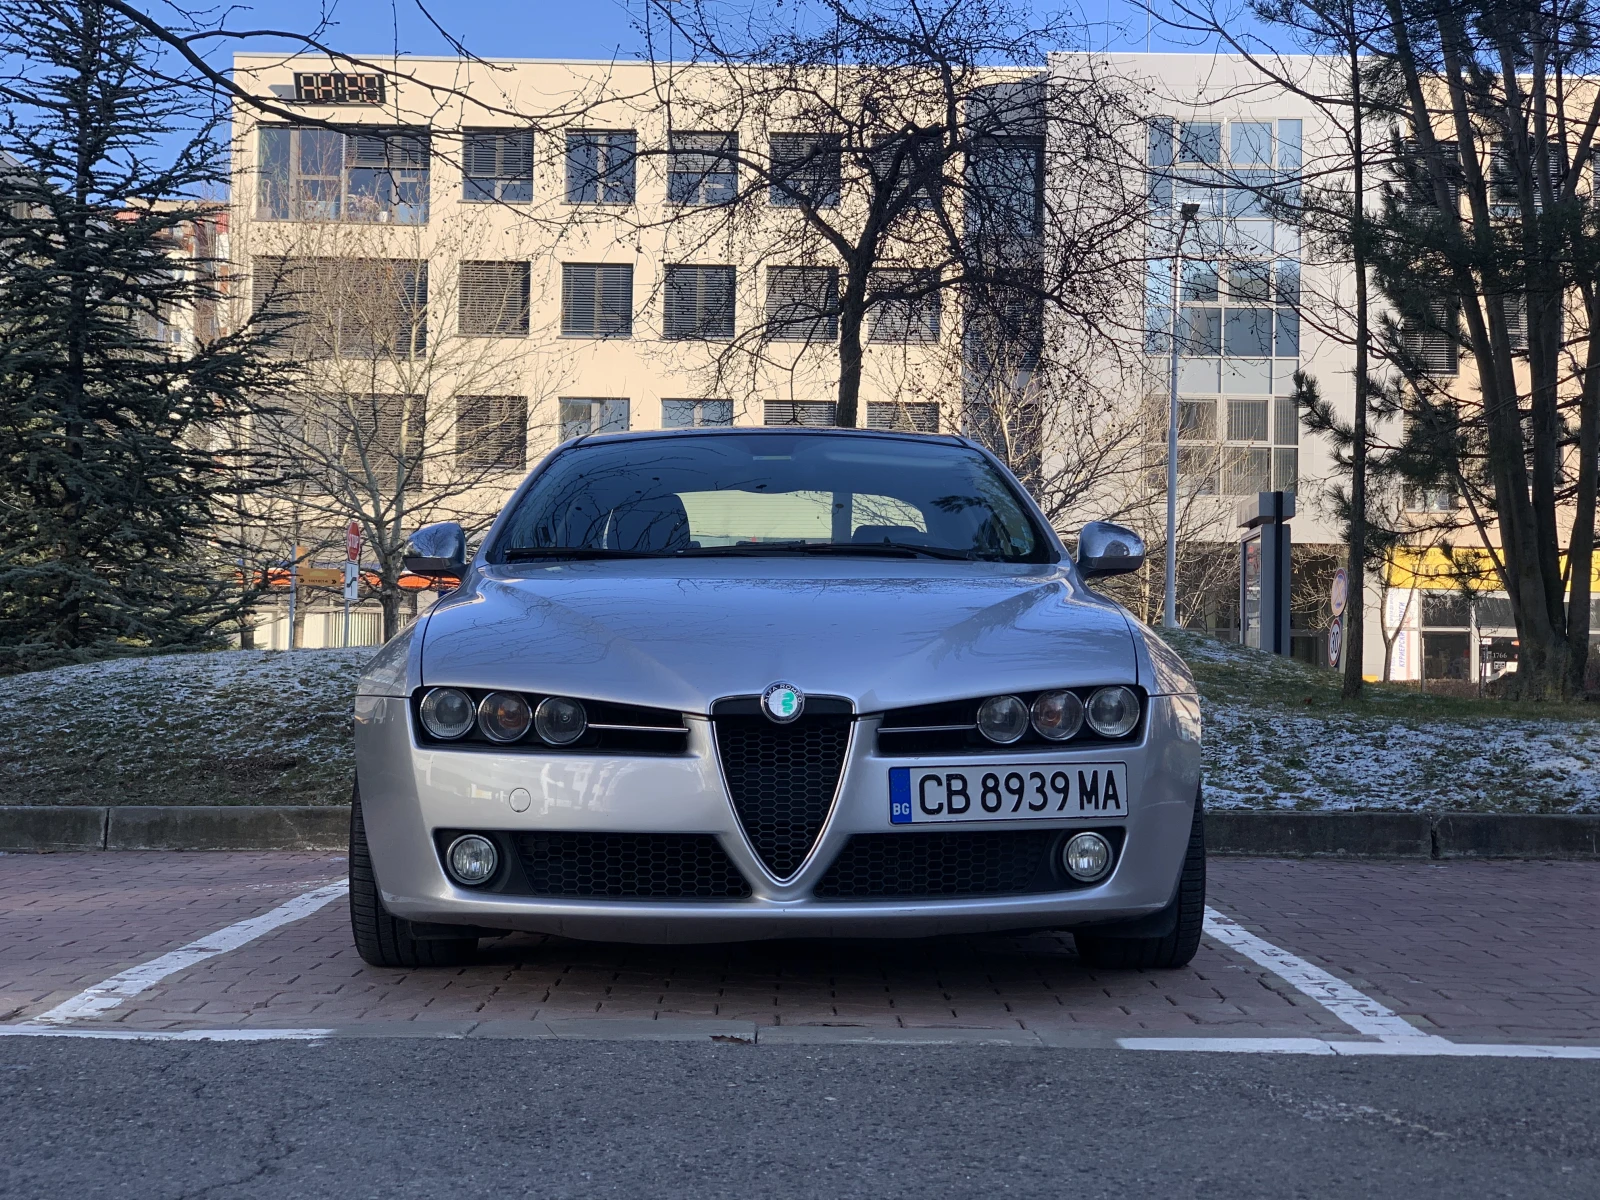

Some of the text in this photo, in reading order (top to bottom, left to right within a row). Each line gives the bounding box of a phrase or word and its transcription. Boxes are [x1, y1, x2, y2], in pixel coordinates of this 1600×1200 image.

[1331, 631, 1340, 654] 30
[763, 684, 803, 703] ALFA ROMEO
[918, 769, 1121, 816] CB 8939 MA
[892, 803, 910, 816] BG
